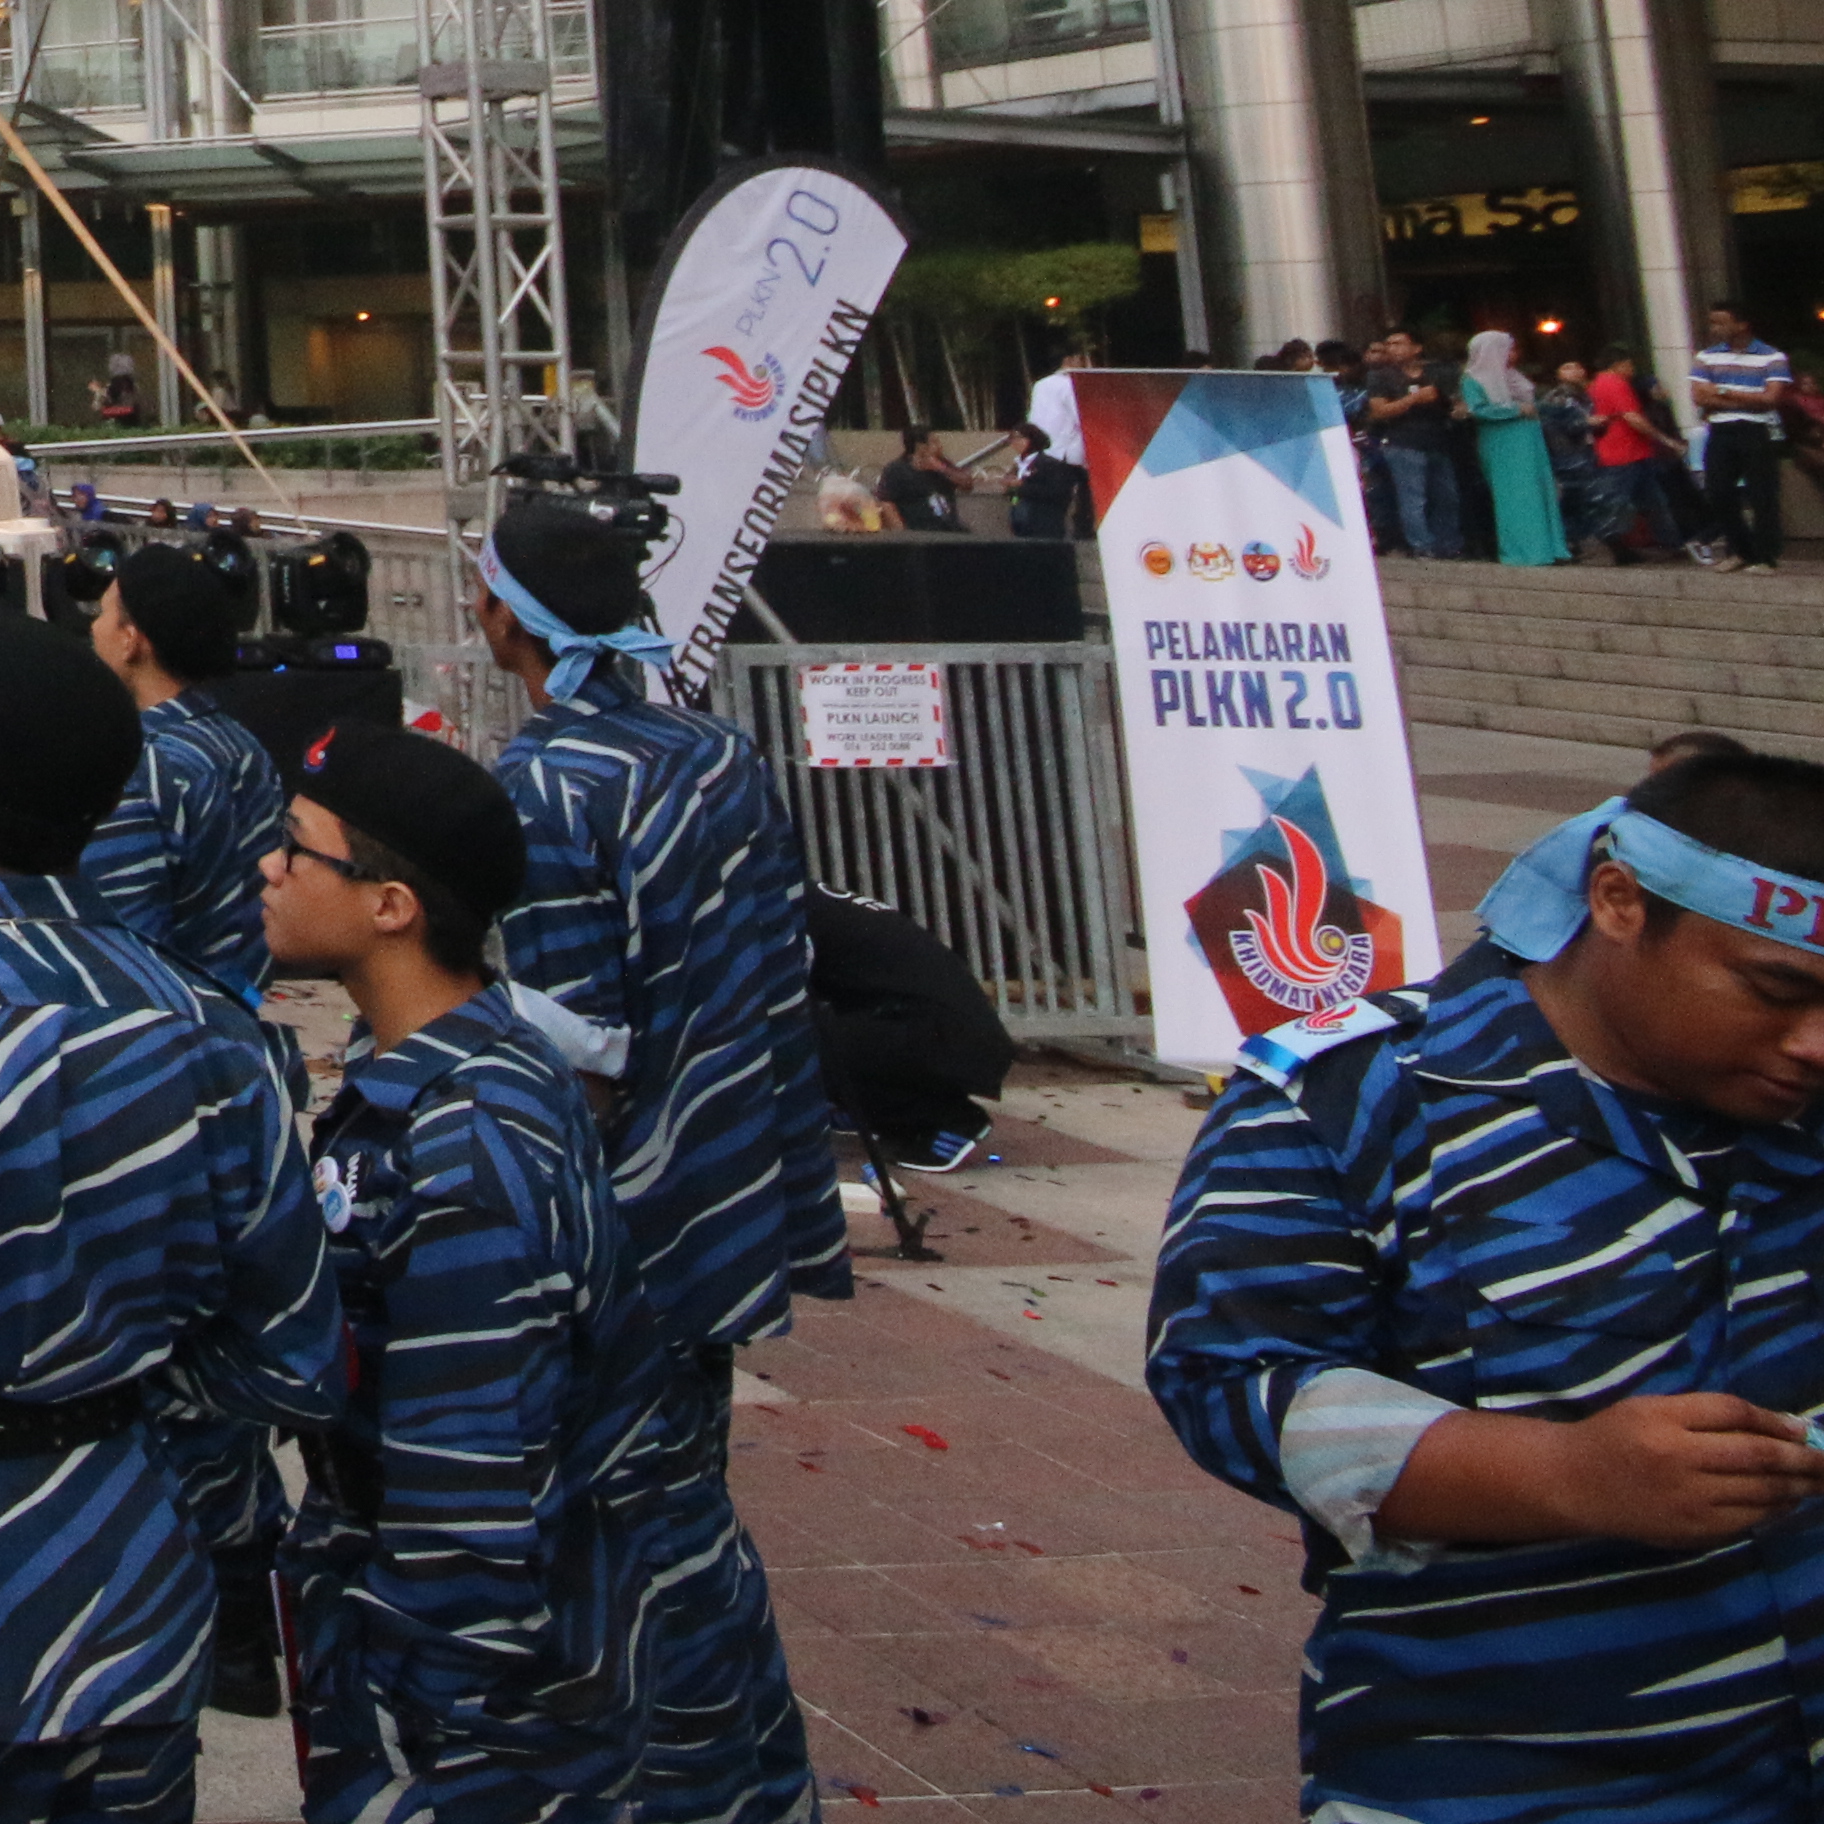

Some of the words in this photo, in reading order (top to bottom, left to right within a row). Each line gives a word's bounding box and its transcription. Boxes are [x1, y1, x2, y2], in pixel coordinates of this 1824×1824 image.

[735, 265, 787, 337] PLKN
[766, 189, 841, 287] 2.0
[1143, 620, 1352, 663] PELANCARAN
[810, 675, 849, 685] WORK
[852, 675, 864, 684] IN
[867, 675, 926, 685] PROGRESS
[846, 687, 870, 696] KEEP
[874, 686, 897, 696] OUT
[1151, 669, 1274, 728] PLKN
[1284, 671, 1363, 730] 2.0
[827, 712, 861, 724] PLKN
[865, 712, 919, 724] LAUNCH
[1228, 928, 1317, 1013] KHIDMAT
